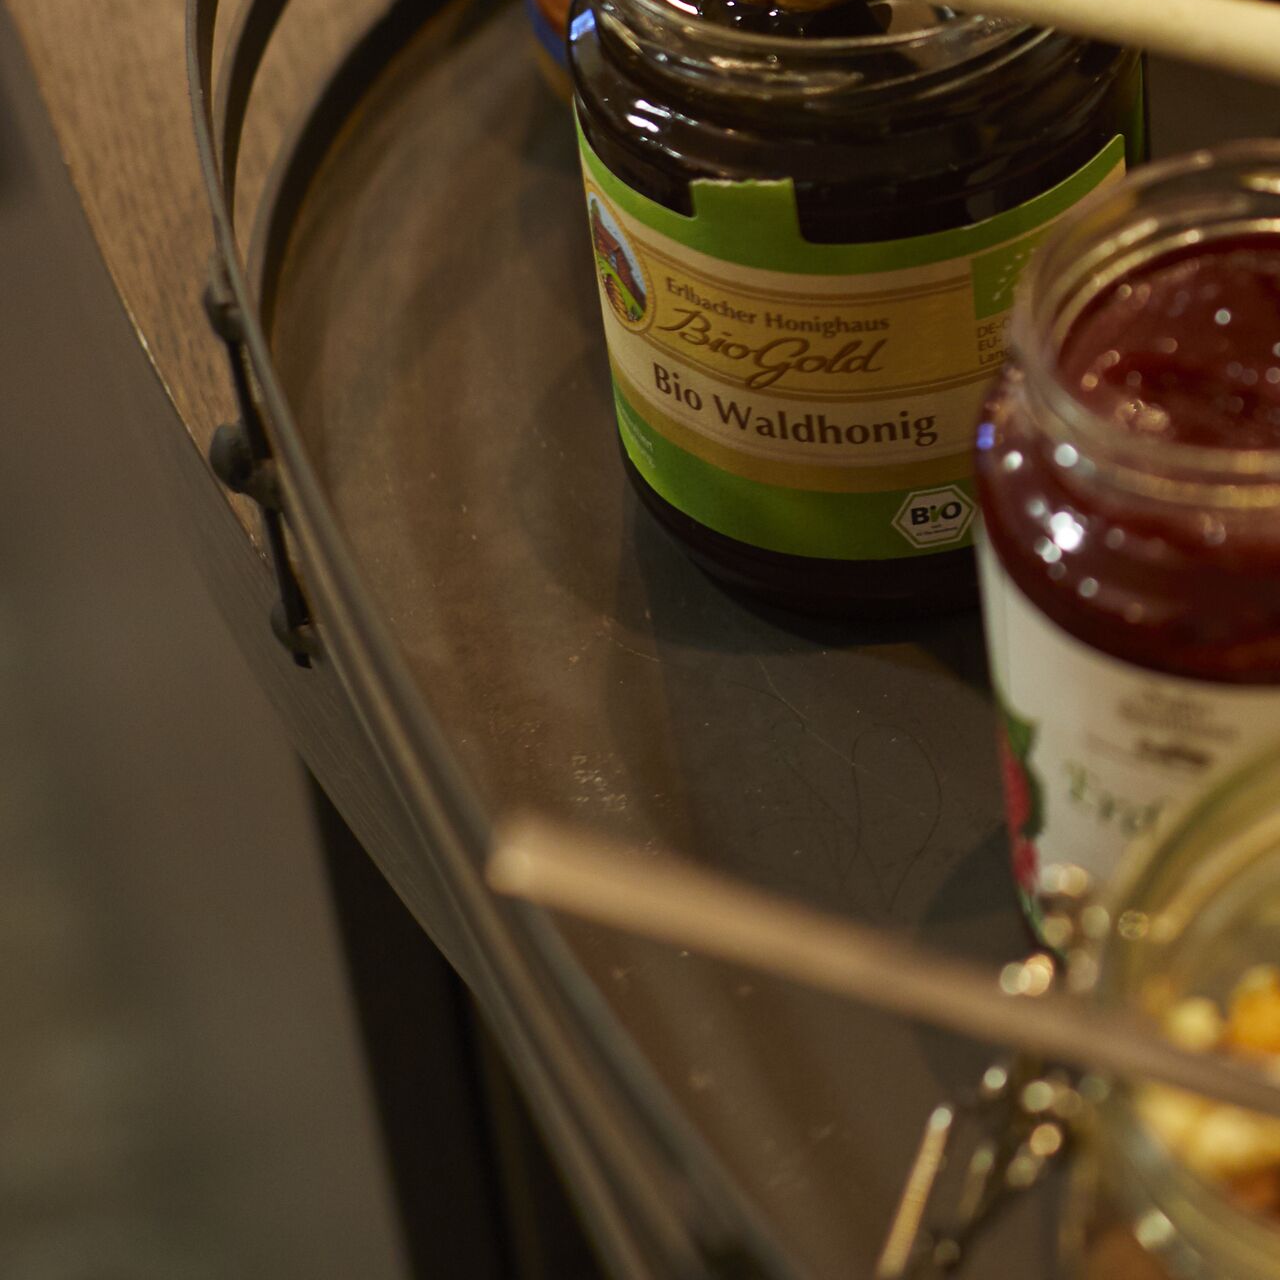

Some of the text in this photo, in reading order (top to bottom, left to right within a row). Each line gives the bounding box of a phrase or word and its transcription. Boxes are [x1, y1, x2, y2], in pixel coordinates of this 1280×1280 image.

[665, 276, 891, 339] Erlbacher Honighaus
[652, 362, 704, 412] Bio
[713, 393, 938, 447] Waldhonig
